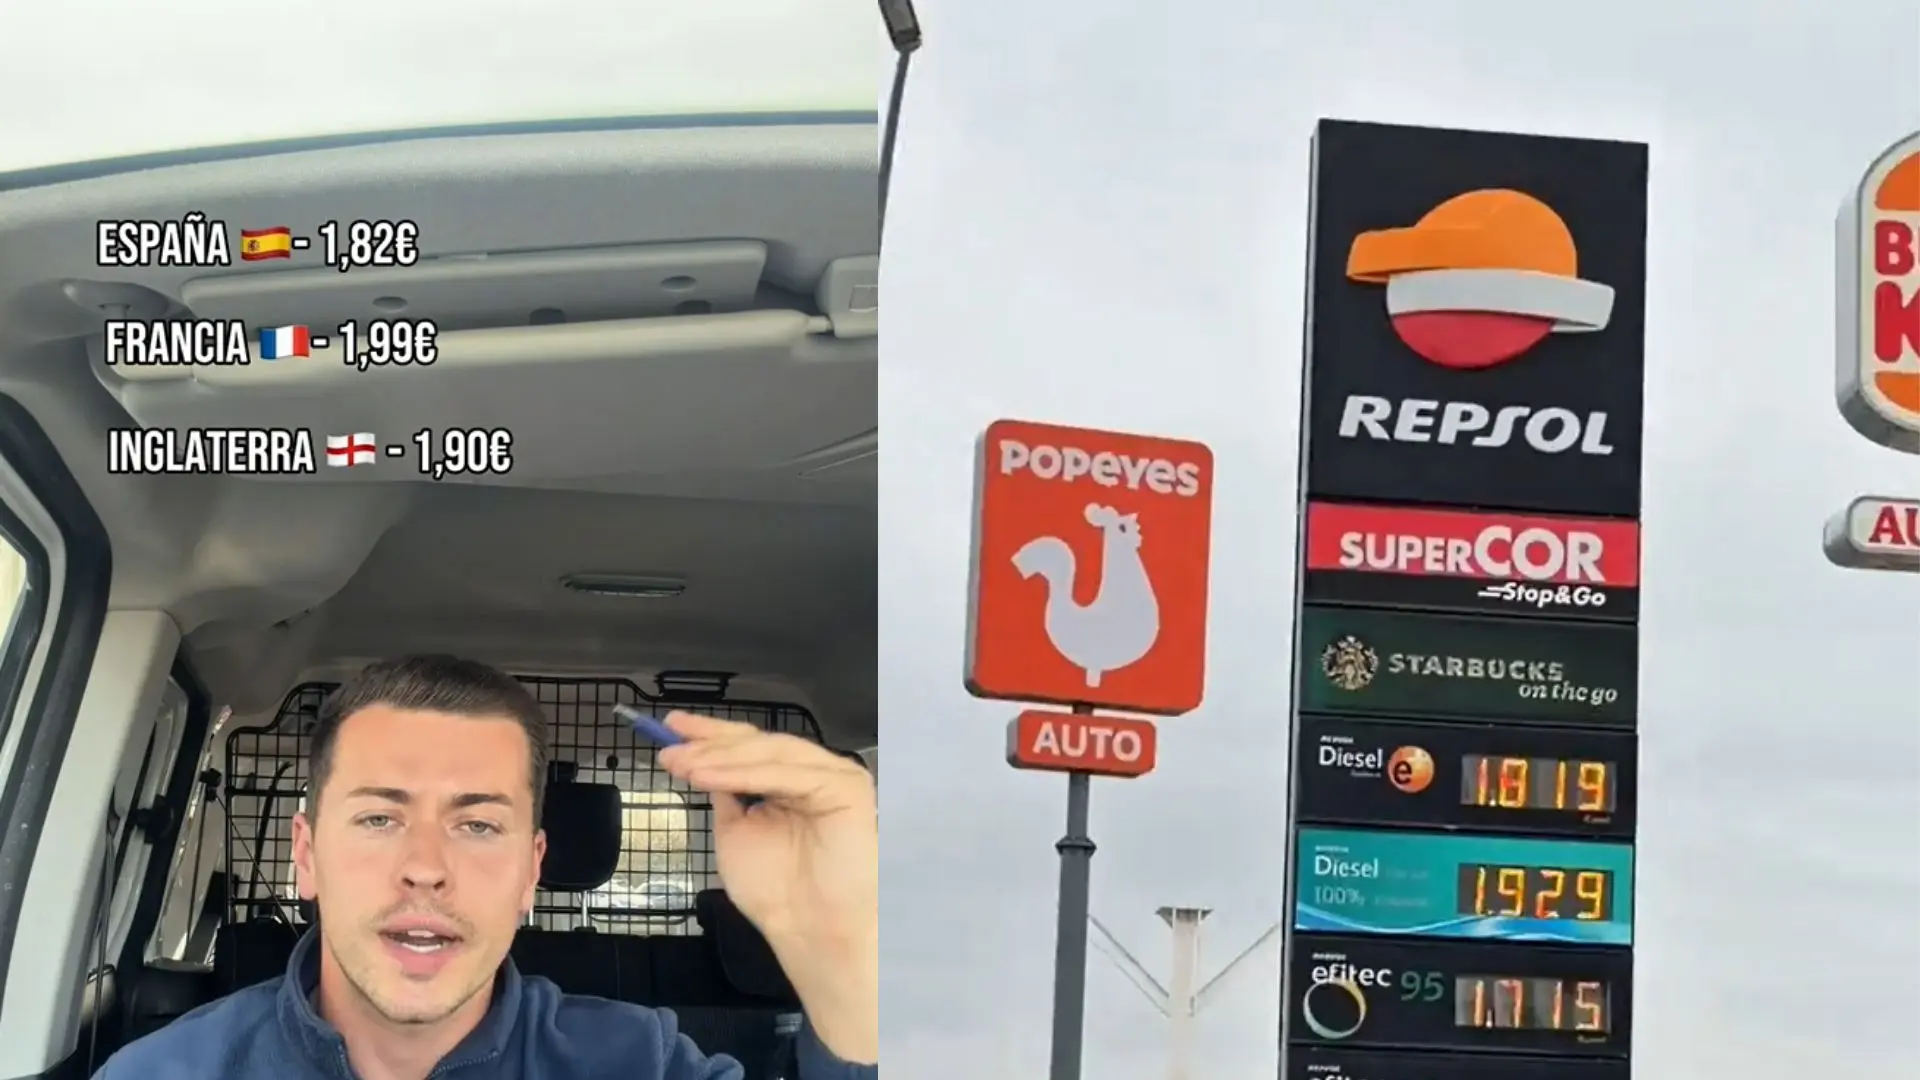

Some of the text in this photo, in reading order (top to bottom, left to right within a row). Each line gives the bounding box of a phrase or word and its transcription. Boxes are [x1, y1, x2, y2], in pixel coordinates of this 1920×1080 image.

[1875, 220, 1920, 276] B
[1339, 395, 1614, 455] REPSOL
[1339, 525, 1606, 583] SUPERCOR
[1503, 581, 1606, 608] Stop&Go
[1388, 653, 1564, 682] STARBUCKS
[1518, 681, 1618, 706] on the go
[1032, 722, 1142, 762] AUTO
[1319, 745, 1383, 769] Diesel
[1477, 758, 1606, 812] 1.819
[1314, 855, 1379, 878] Diesel
[1475, 866, 1604, 919] 1.929
[1311, 963, 1445, 1001] efitec 95
[1474, 979, 1601, 1031] 1.715
